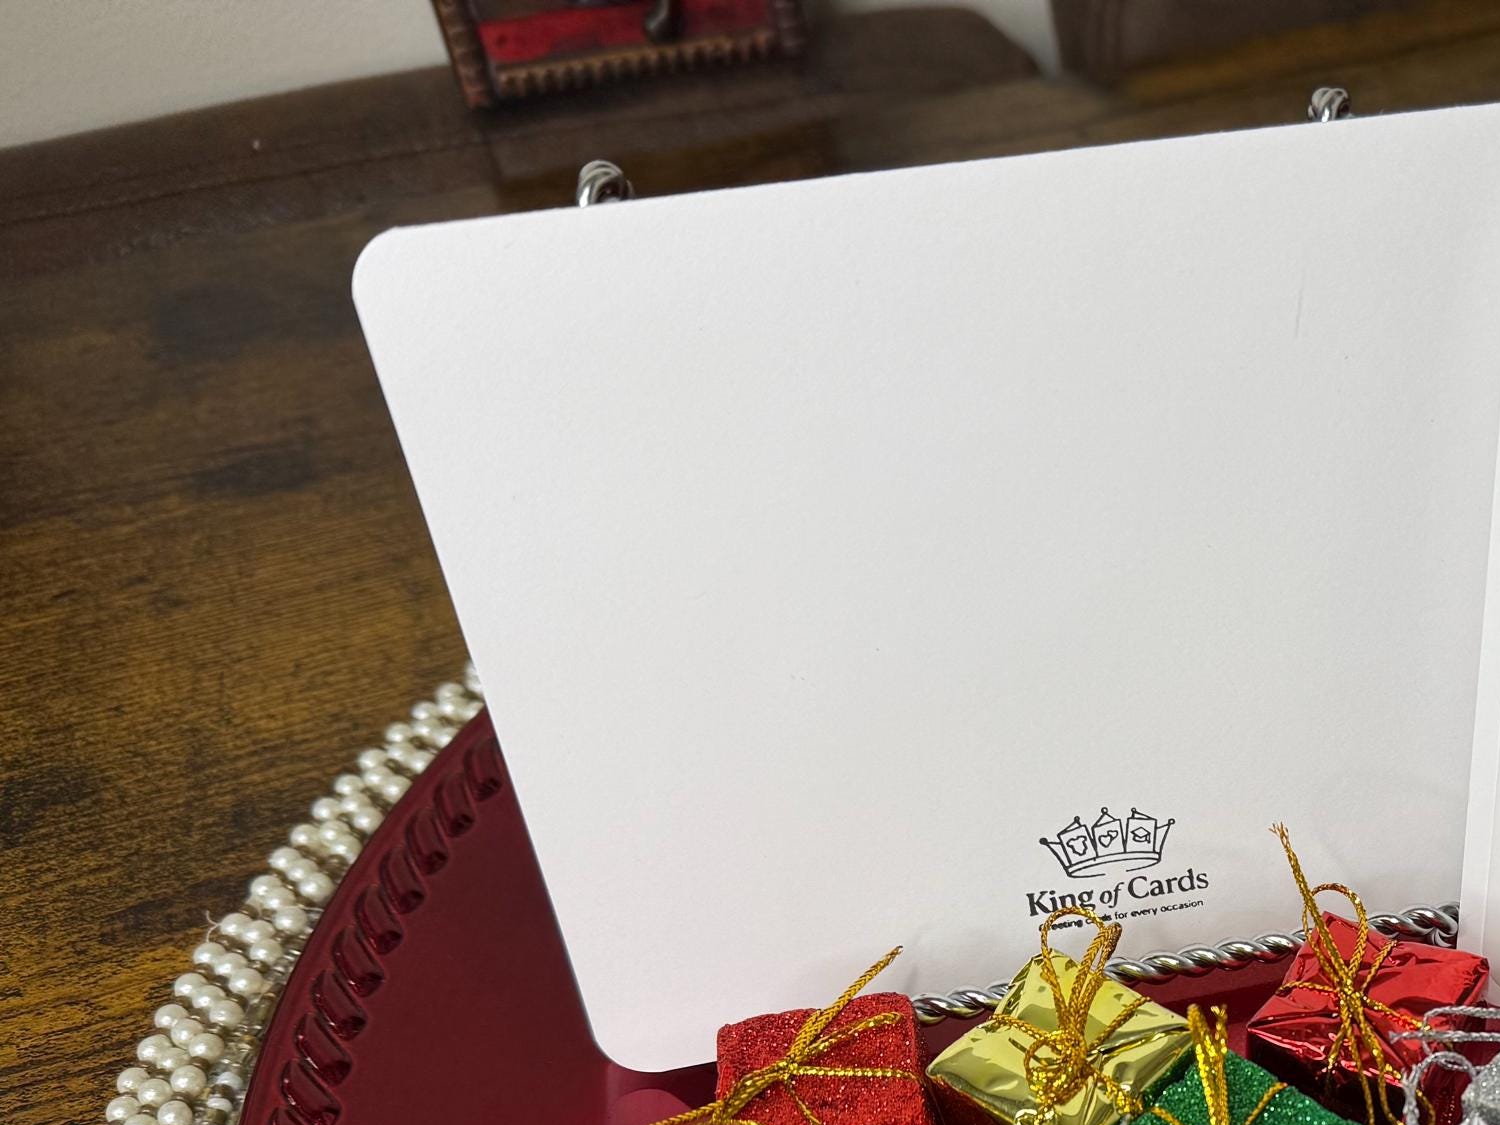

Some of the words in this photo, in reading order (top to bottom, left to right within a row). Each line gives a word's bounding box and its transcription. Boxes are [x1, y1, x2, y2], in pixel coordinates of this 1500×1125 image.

[1026, 889, 1097, 917] King
[1099, 881, 1125, 909] of
[1128, 868, 1210, 900] Cards
[1114, 911, 1128, 920] for
[1130, 907, 1158, 917] every
[1160, 900, 1204, 913] occasion
